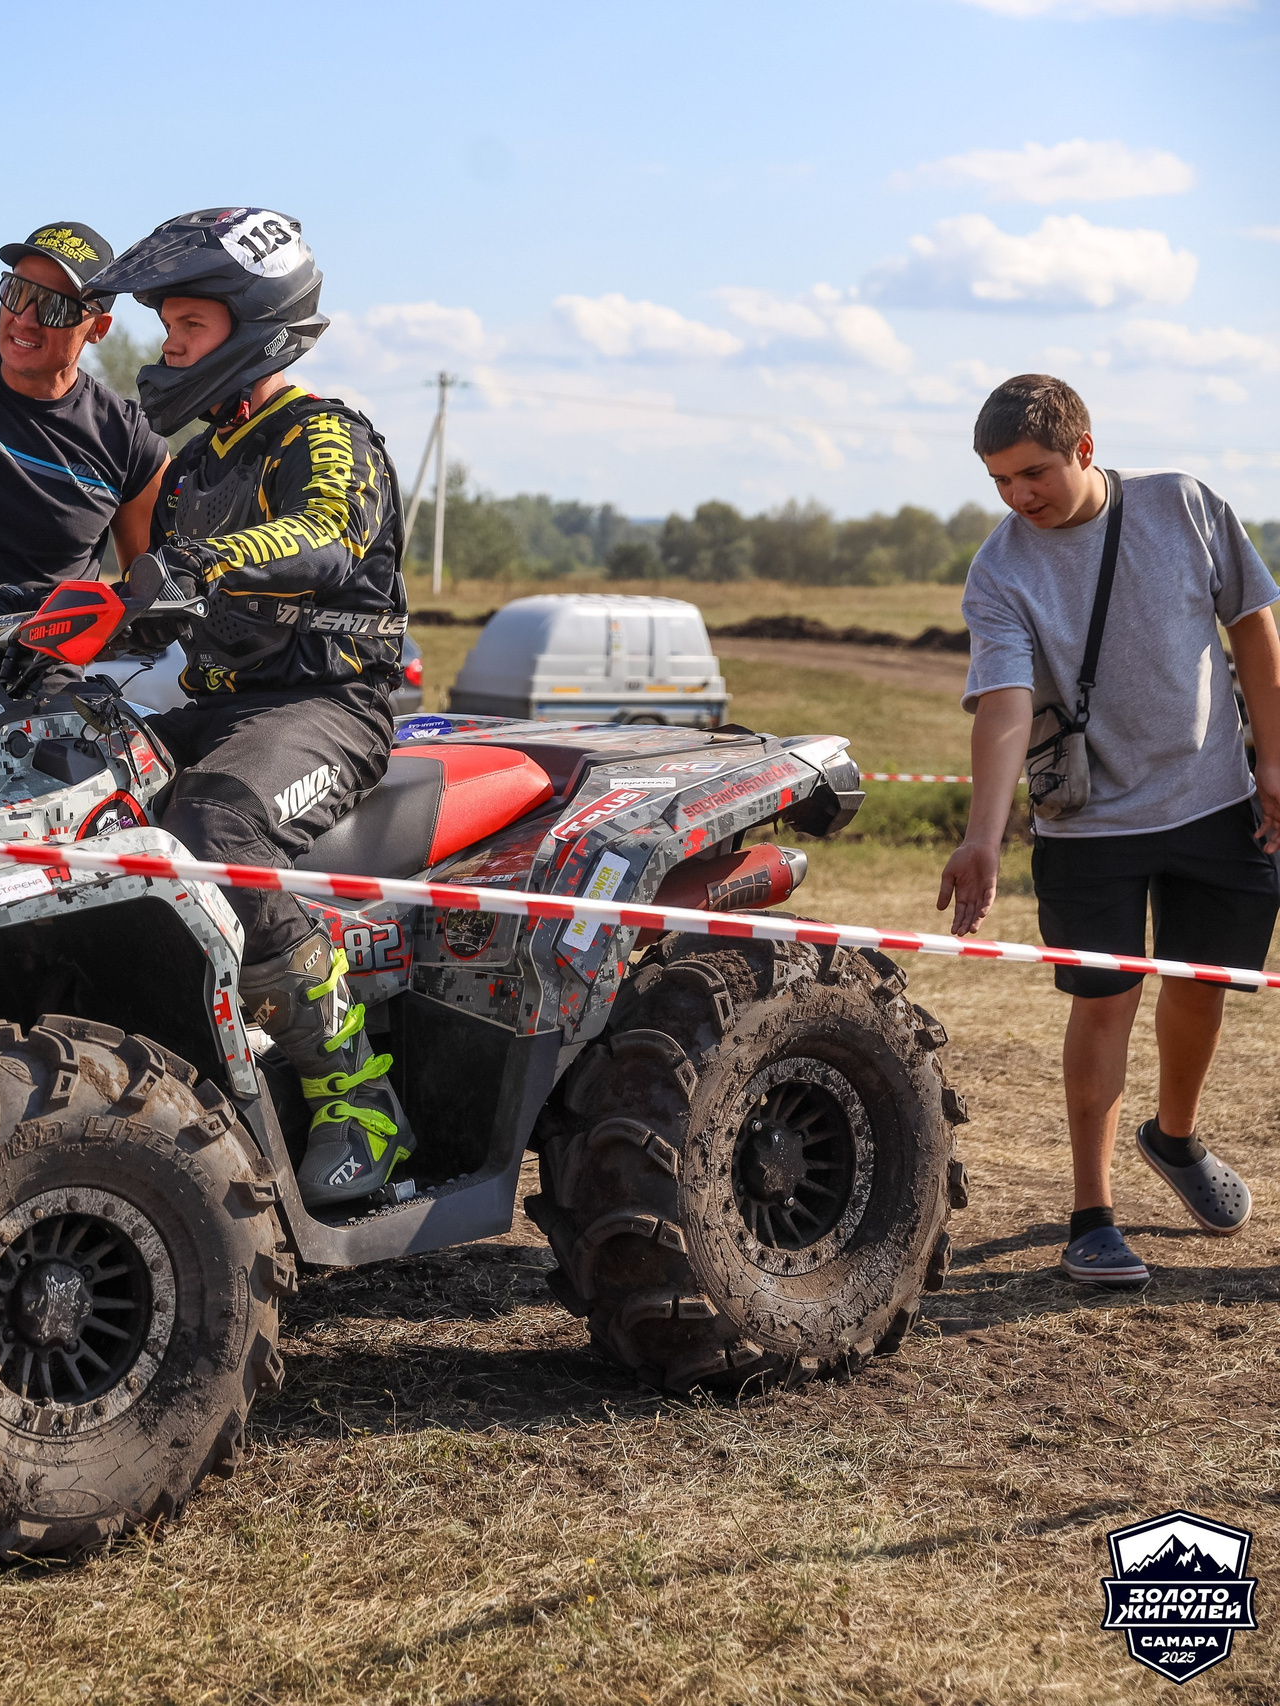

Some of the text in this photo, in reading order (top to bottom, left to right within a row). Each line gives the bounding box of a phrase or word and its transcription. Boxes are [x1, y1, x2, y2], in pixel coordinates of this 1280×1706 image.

[237, 219, 292, 264] 119
[29, 620, 72, 641] can-am
[273, 764, 333, 829] YOKO
[605, 870, 621, 896] AXLES
[304, 945, 323, 974] GTX
[82, 1114, 176, 1156] LITE
